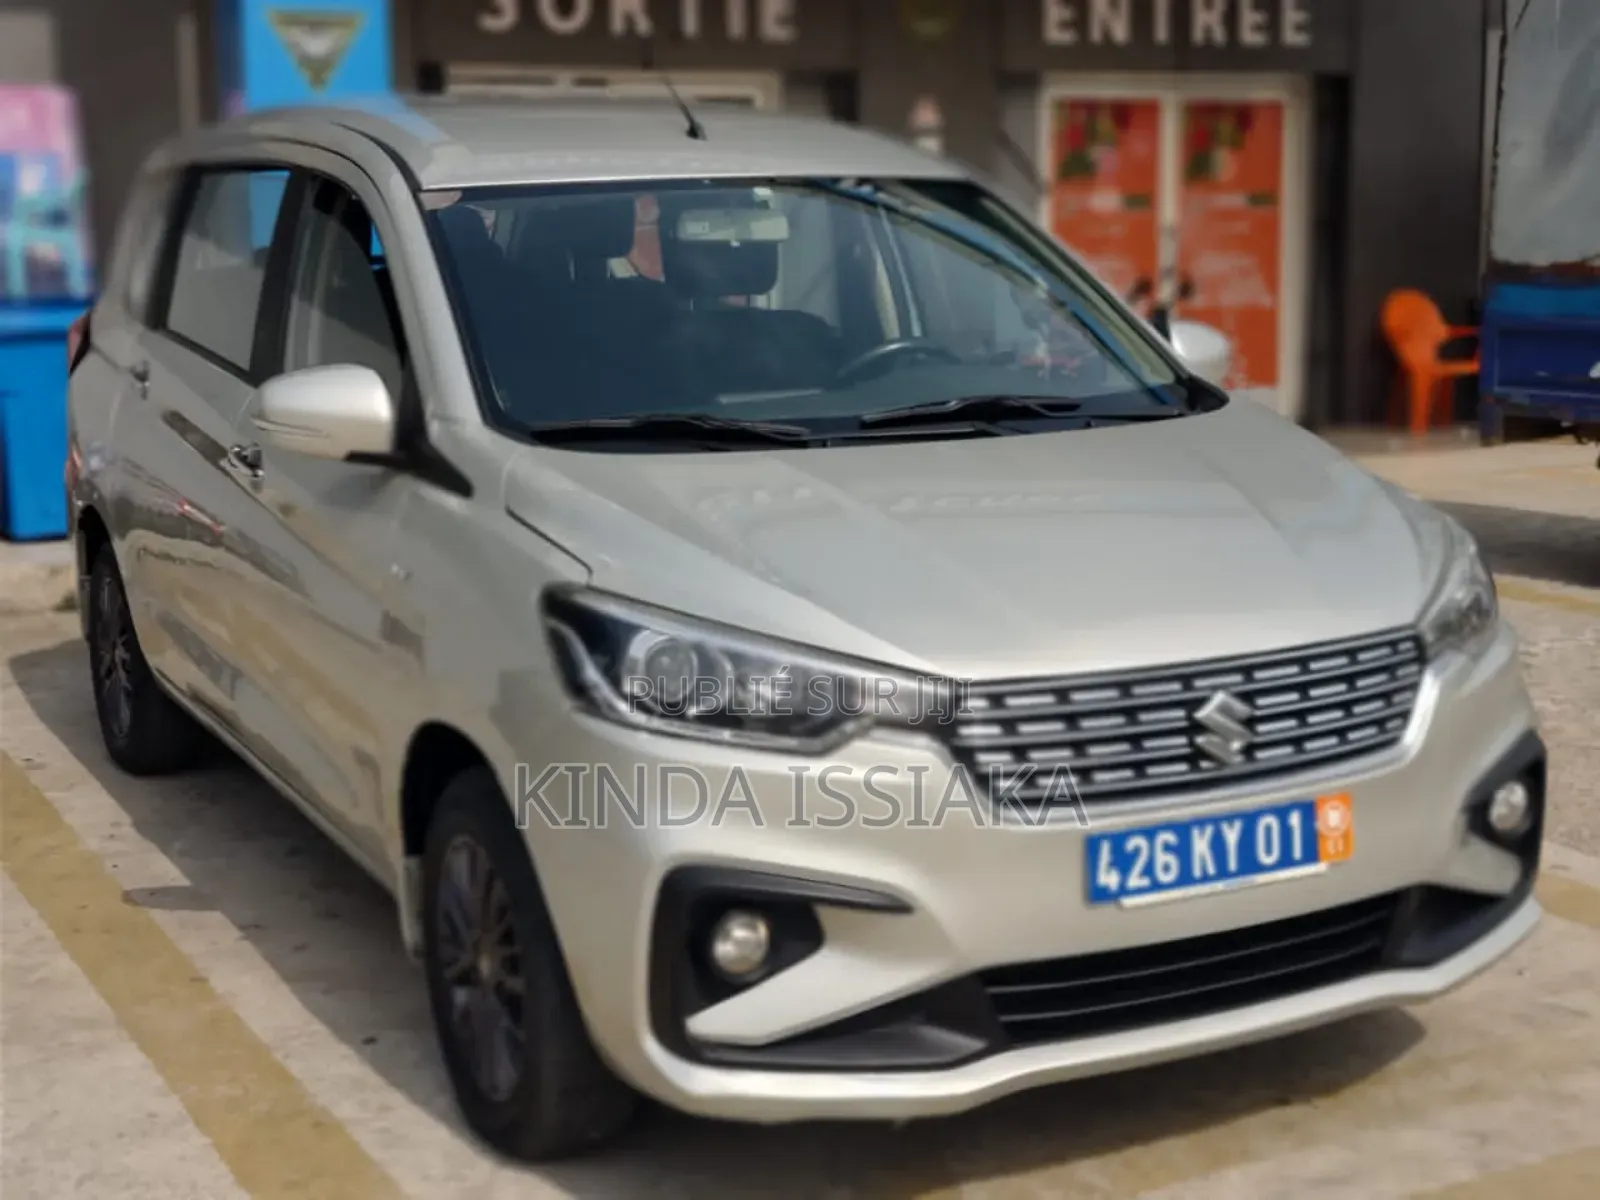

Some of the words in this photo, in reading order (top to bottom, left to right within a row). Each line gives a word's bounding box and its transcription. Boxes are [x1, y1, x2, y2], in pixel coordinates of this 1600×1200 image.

[1096, 831, 1179, 892] 426
[1191, 819, 1241, 878] KY
[1256, 810, 1302, 865] 01
